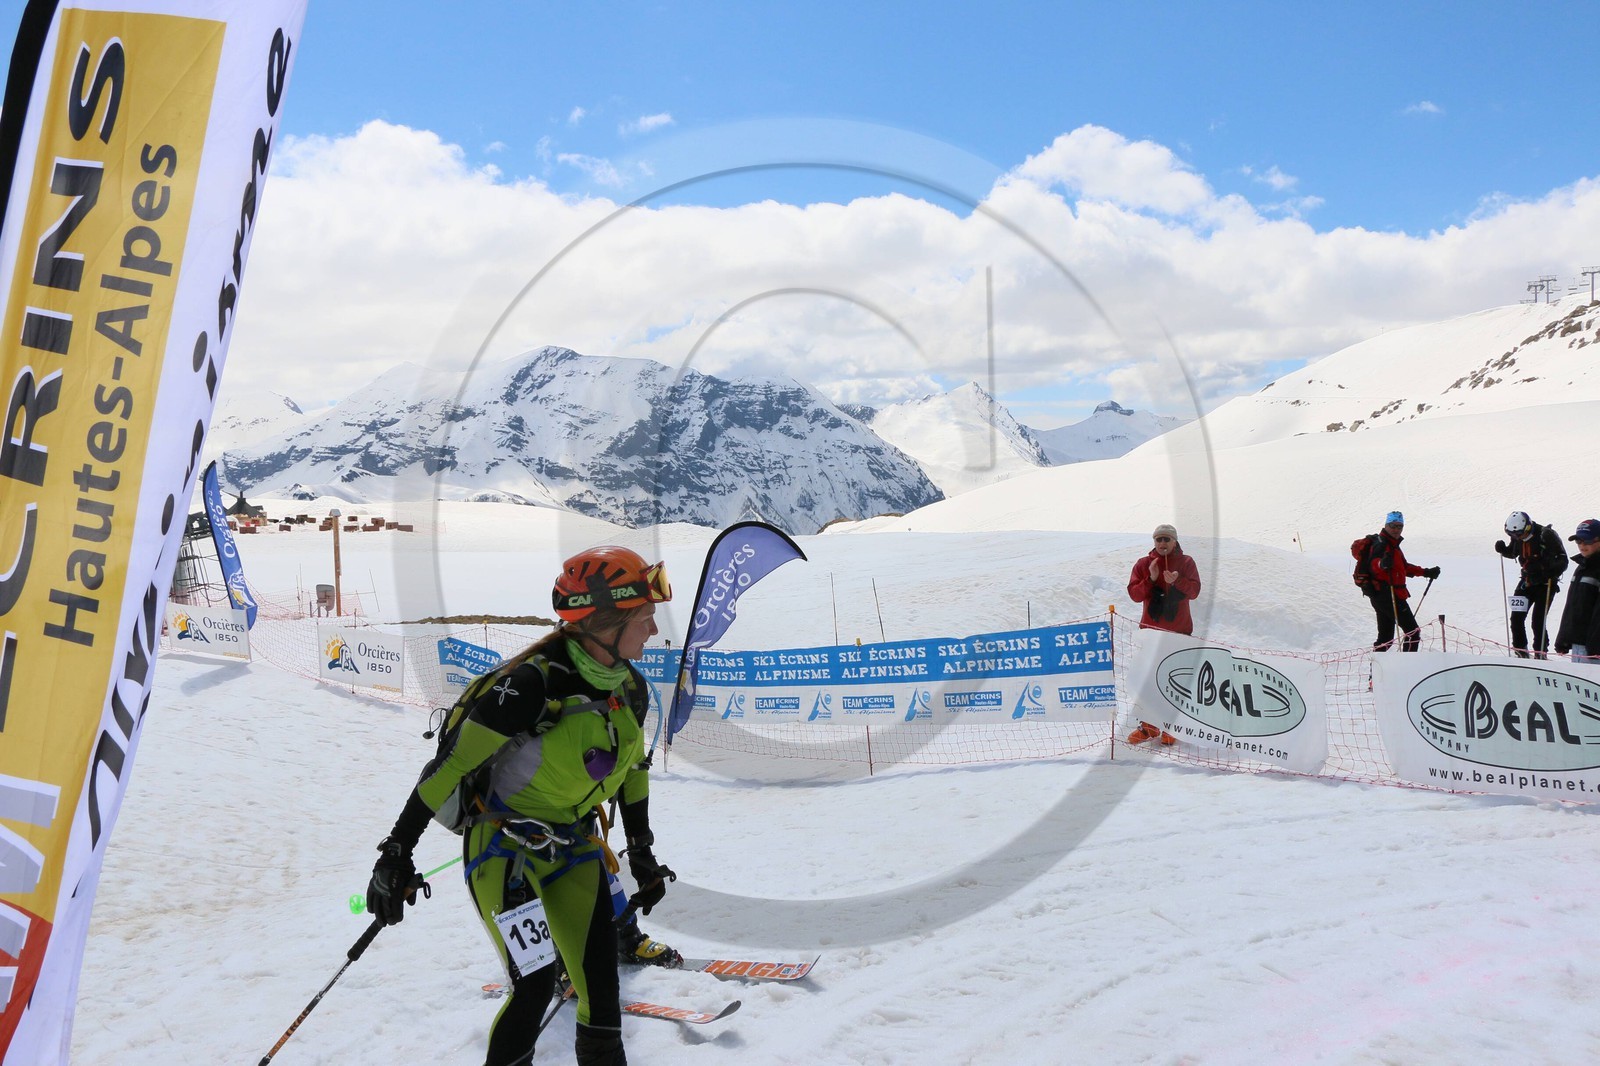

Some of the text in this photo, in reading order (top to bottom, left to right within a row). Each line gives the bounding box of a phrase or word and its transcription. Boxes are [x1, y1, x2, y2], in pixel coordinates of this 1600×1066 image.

[43, 142, 178, 648] Hautes-Alpes
[694, 543, 756, 630] Orcières
[202, 616, 246, 633] Orcières
[214, 633, 239, 643] 1850
[1054, 625, 1112, 648] SKI É
[357, 641, 402, 662] Orcières
[838, 646, 927, 664] SKI ÉCRINS
[937, 635, 1042, 658] SKI ÉCRINS
[366, 662, 393, 675] 1850
[780, 652, 830, 666] ÉCRINS
[942, 655, 1043, 675] ALPINISME
[754, 668, 832, 682] ALPINISME
[841, 663, 929, 680] ALPINISME
[1232, 663, 1294, 697] THE DYNAMIC
[1196, 659, 1262, 718] BEAL
[1536, 676, 1558, 688] THE
[755, 697, 799, 709] TEAM ÉCRINS
[844, 696, 893, 708] TEAM ÉCRINS
[945, 691, 1001, 706] TEAM ÉCRINS
[1060, 689, 1088, 701] TEAM
[1165, 685, 1201, 716] COMPANY
[1464, 680, 1582, 745] BEAL
[1420, 720, 1470, 753] COMPANY
[509, 917, 552, 951] 13a
